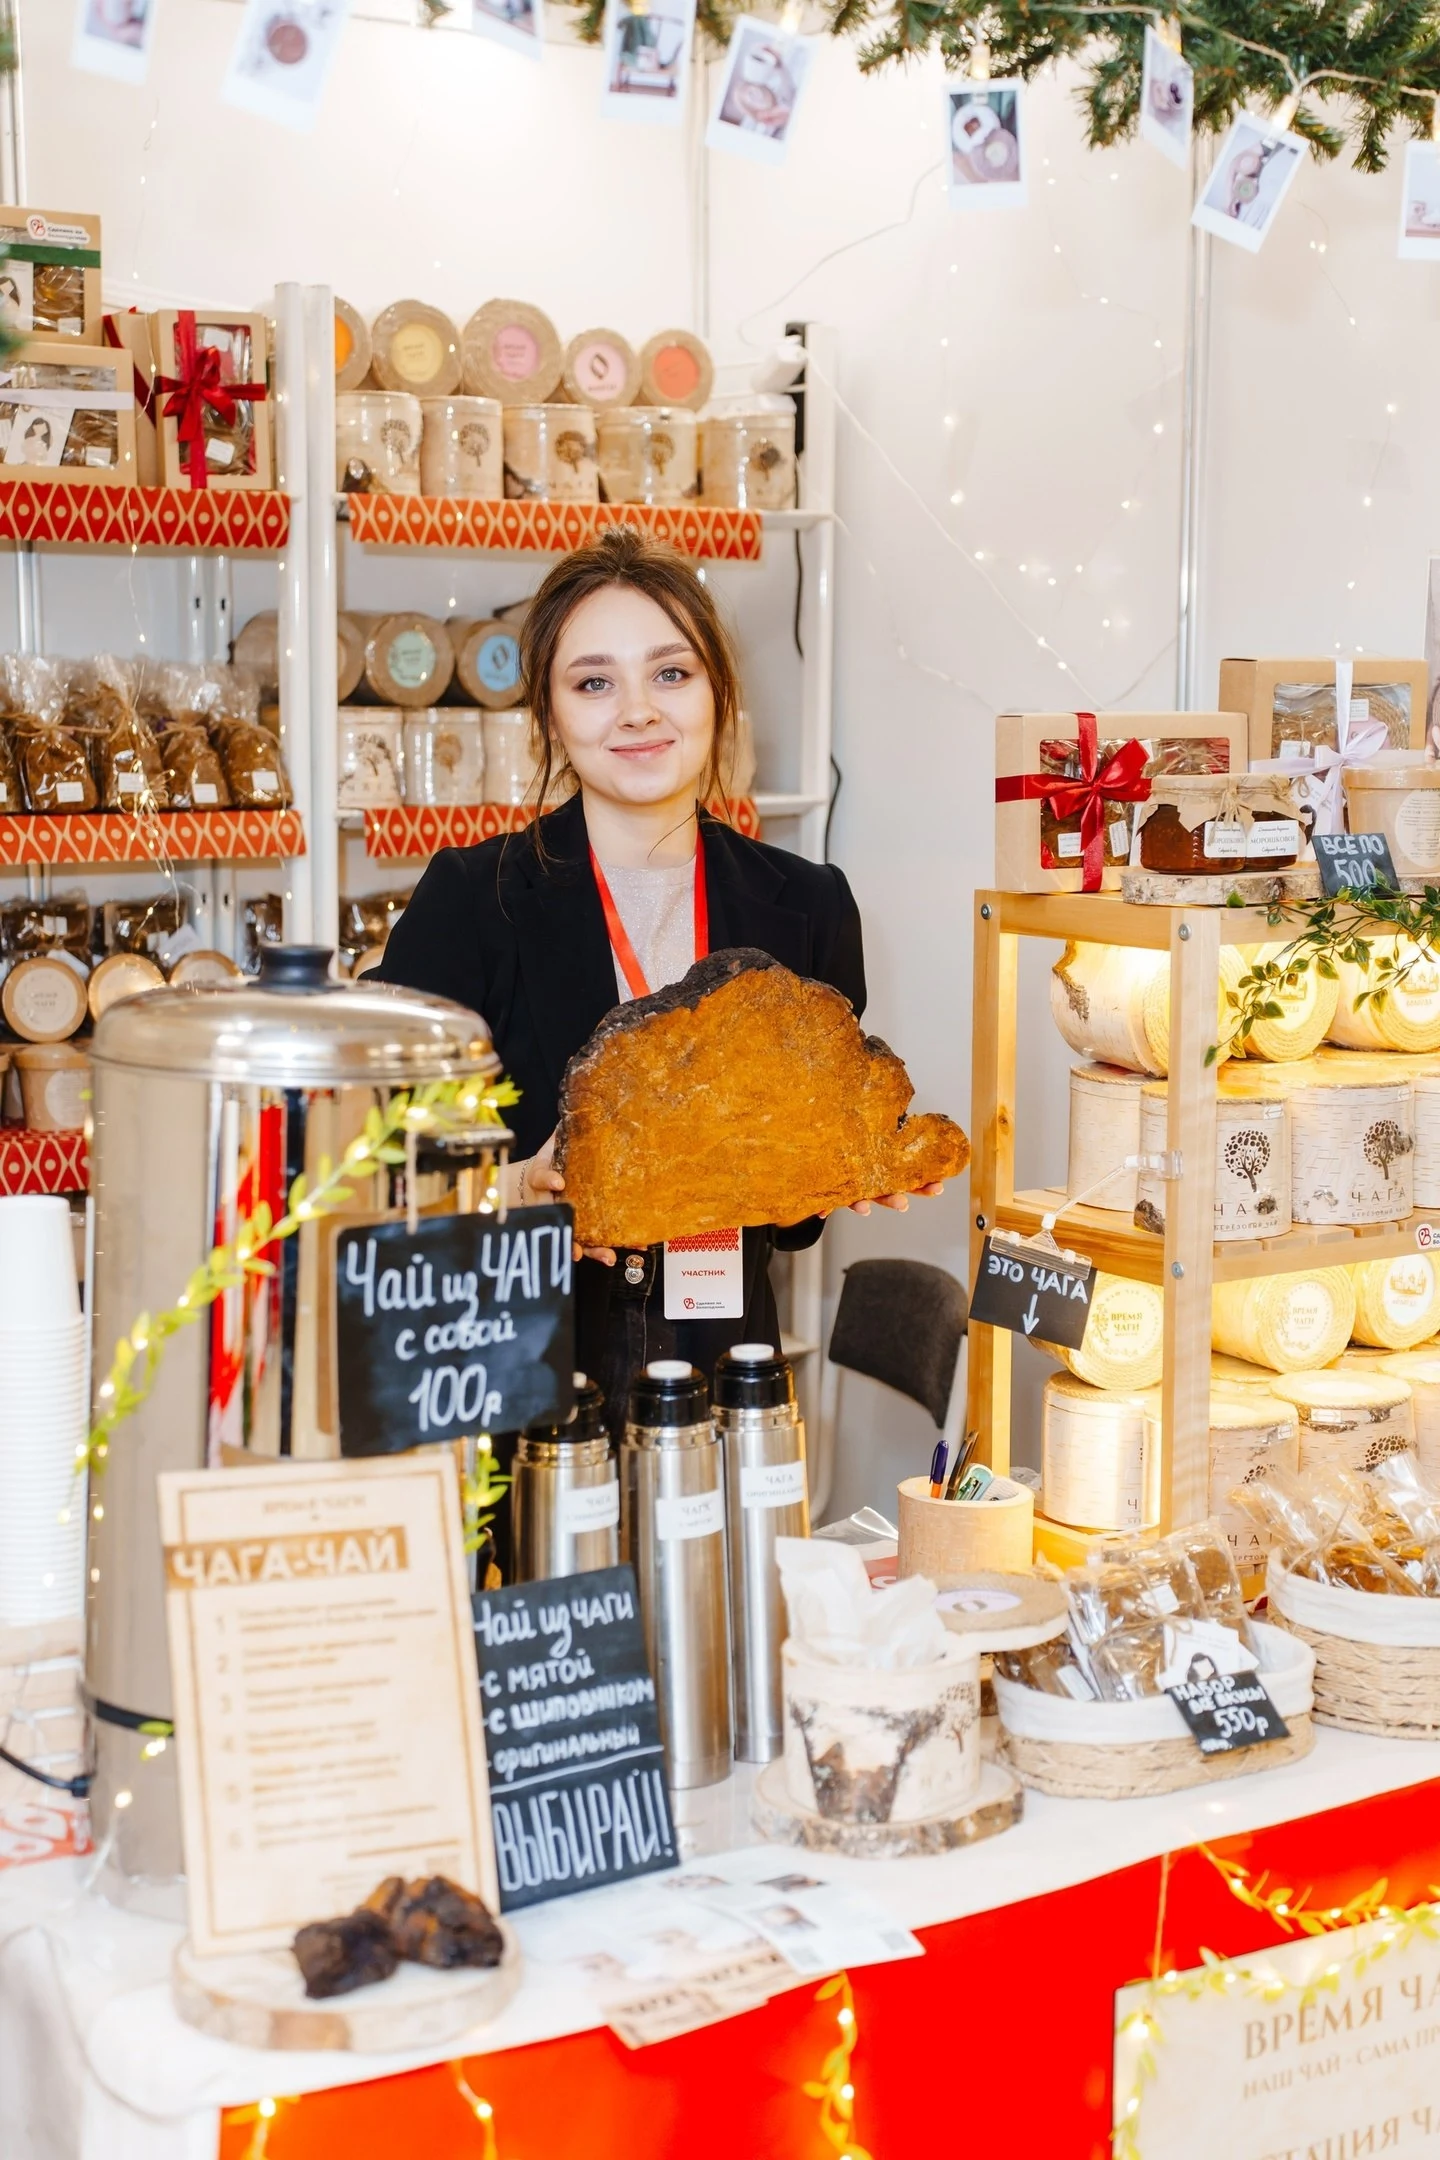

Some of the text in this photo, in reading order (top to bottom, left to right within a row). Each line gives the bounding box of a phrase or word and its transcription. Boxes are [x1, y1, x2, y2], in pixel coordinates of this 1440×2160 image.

[1320, 833, 1358, 856] ВСЕ
[1333, 859, 1377, 888] 500
[1351, 1186, 1407, 1204] ЧАГА
[345, 1225, 573, 1327] Чай из ЧАГИ
[987, 1254, 1089, 1304] ЭТО ЧАГА
[1111, 1312, 1143, 1321] ВРЕМЯ
[1292, 1306, 1318, 1315] ВРЕМЯ
[1293, 1317, 1315, 1325] ЧАГИ
[395, 1311, 518, 1361] с собой
[1113, 1323, 1140, 1333] ЧАГИ
[170, 1527, 398, 1587] ЧАГА-ЧАЙ
[539, 1603, 573, 1658] из
[1172, 1676, 1236, 1701] НАБОР
[1213, 1706, 1269, 1738] 550р
[491, 1768, 674, 1893] ВЫБИРАЙ!
[1244, 1985, 1384, 2060] ВРЕМЯ
[1243, 2068, 1293, 2099] НАШ
[1300, 2053, 1341, 2082] ЧАЙ
[1356, 2036, 1411, 2066] САМА
